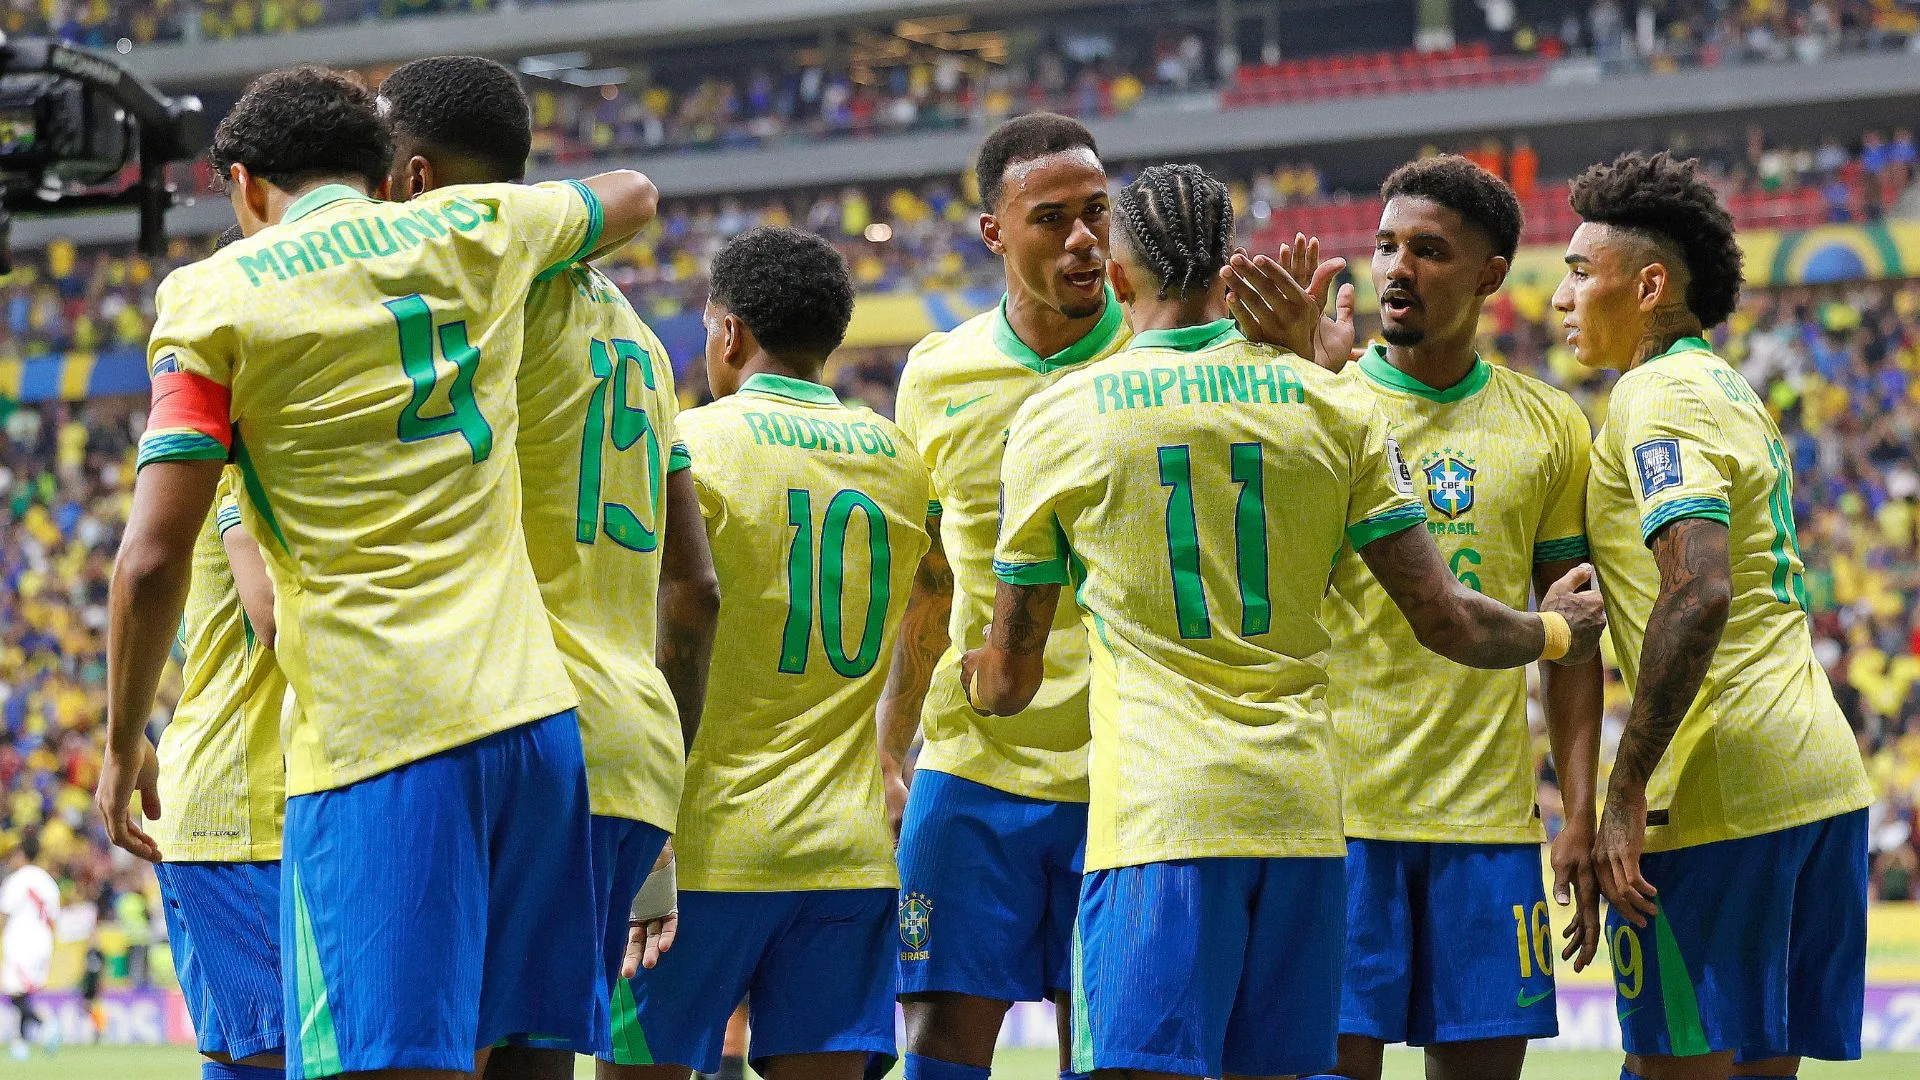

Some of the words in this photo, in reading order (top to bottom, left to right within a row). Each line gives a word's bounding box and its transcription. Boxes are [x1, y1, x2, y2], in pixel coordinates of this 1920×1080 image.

[236, 195, 498, 288] MARQUNHOS
[382, 293, 492, 465] 4
[1092, 364, 1305, 415] RAPHINHA
[576, 337, 658, 552] 15
[742, 411, 897, 459] RODRYGO
[1441, 481, 1460, 490] CBF
[1156, 442, 1272, 640] 11
[1426, 521, 1479, 536] BRASIL
[778, 488, 891, 679] 10
[1449, 547, 1482, 593] 6
[900, 950, 930, 961] BRASIL
[1512, 901, 1553, 978] 16
